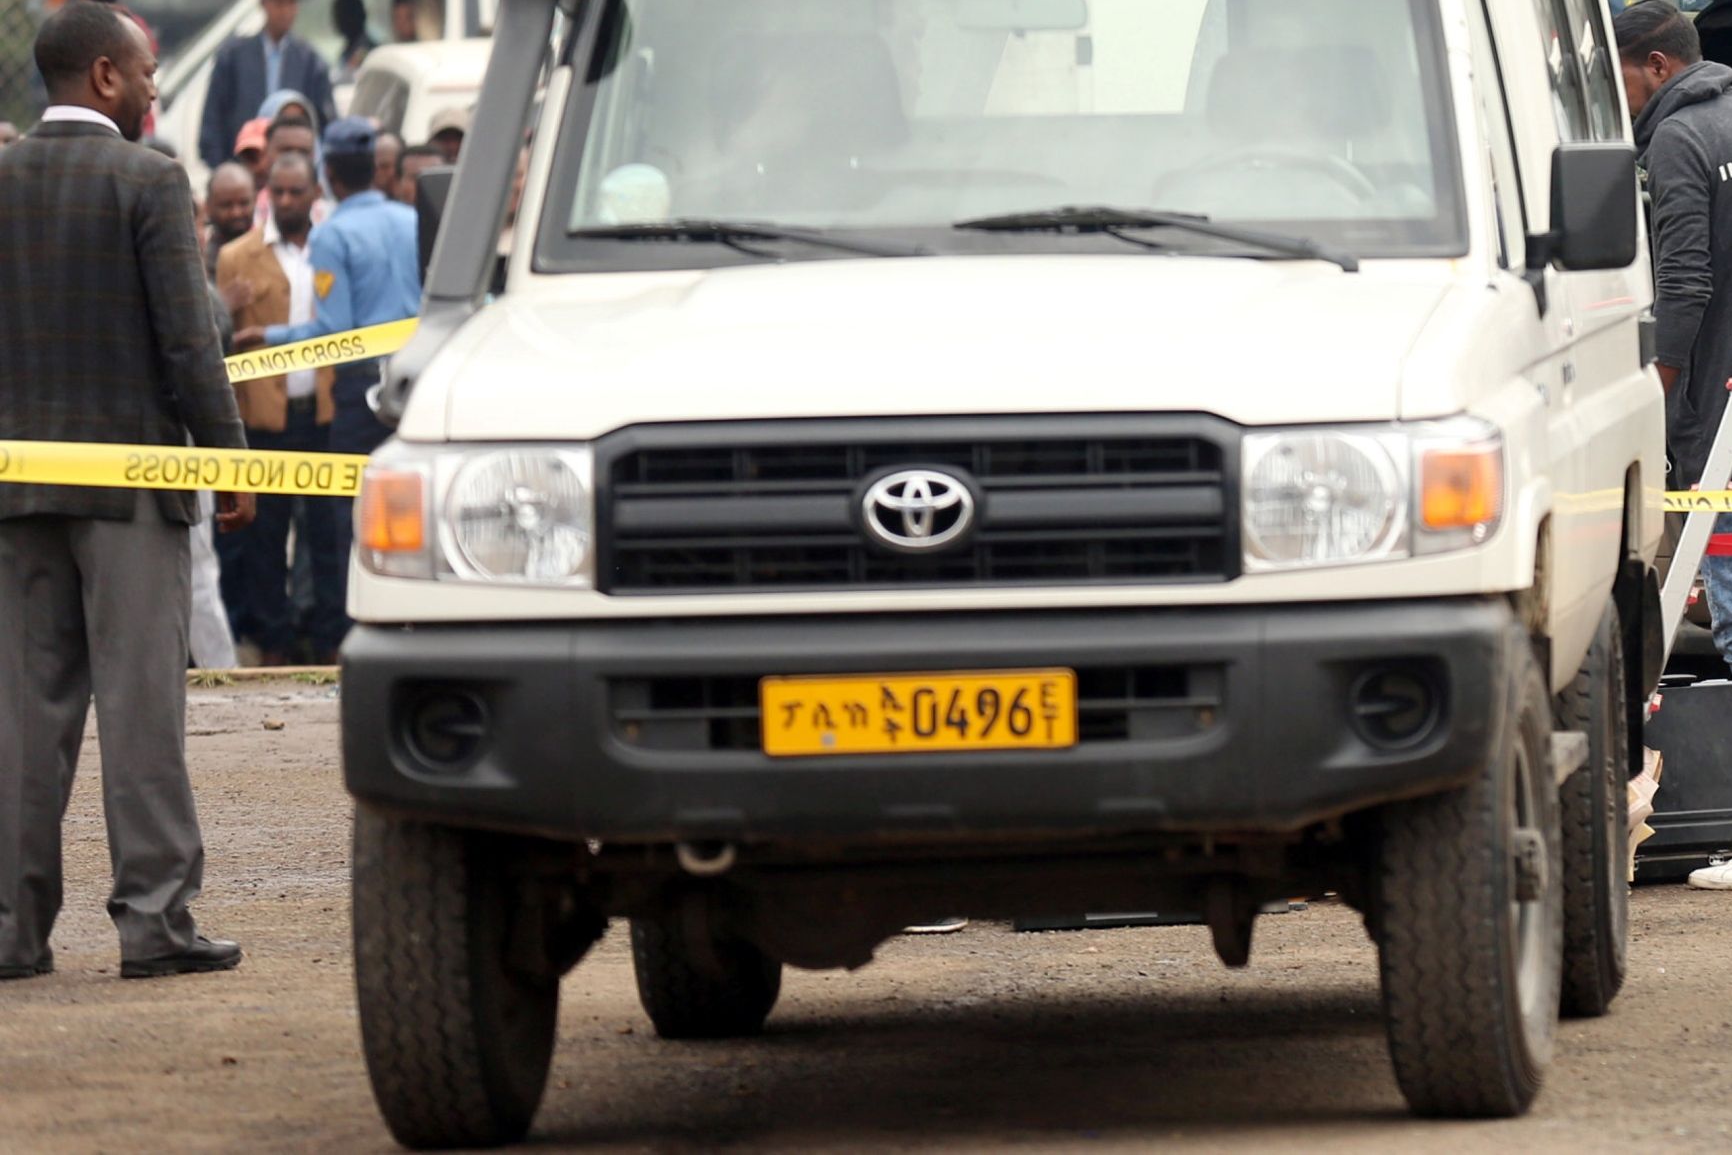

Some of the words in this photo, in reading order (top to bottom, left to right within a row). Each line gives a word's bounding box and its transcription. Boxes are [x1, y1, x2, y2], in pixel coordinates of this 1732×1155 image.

[227, 358, 256, 378] DO
[258, 349, 297, 372] NOT
[301, 335, 366, 365] CROSS
[912, 686, 1033, 739] 0496
